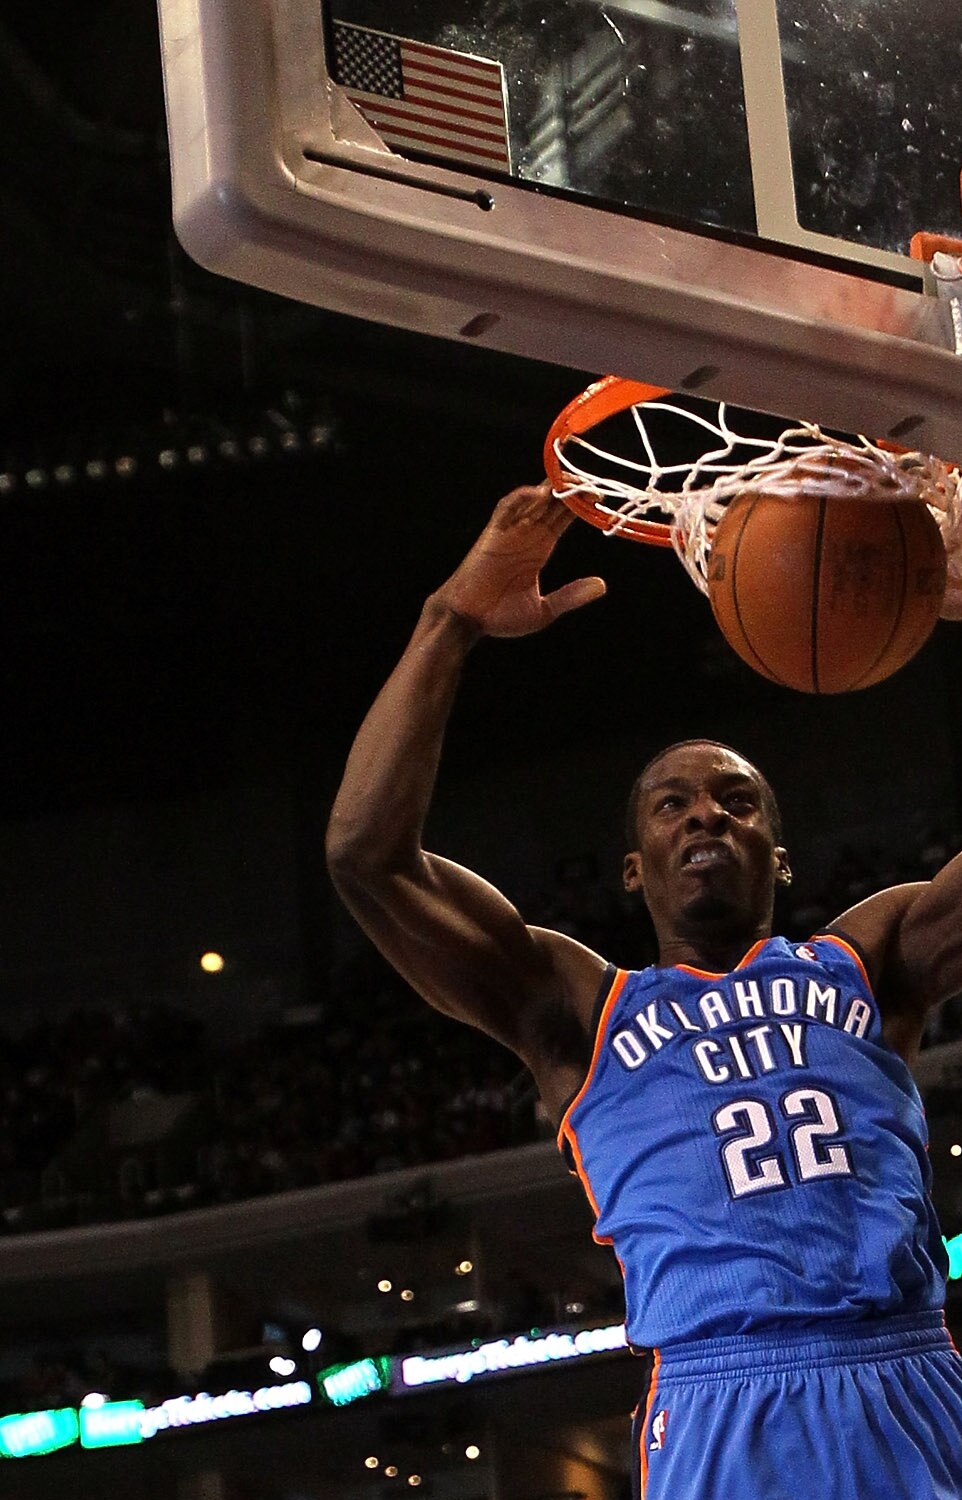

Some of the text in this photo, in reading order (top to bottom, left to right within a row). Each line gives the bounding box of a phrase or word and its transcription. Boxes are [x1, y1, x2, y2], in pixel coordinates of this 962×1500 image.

[611, 976, 873, 1071] OKLAHOMA
[693, 1022, 806, 1084] CITY
[711, 1087, 856, 1200] 22
